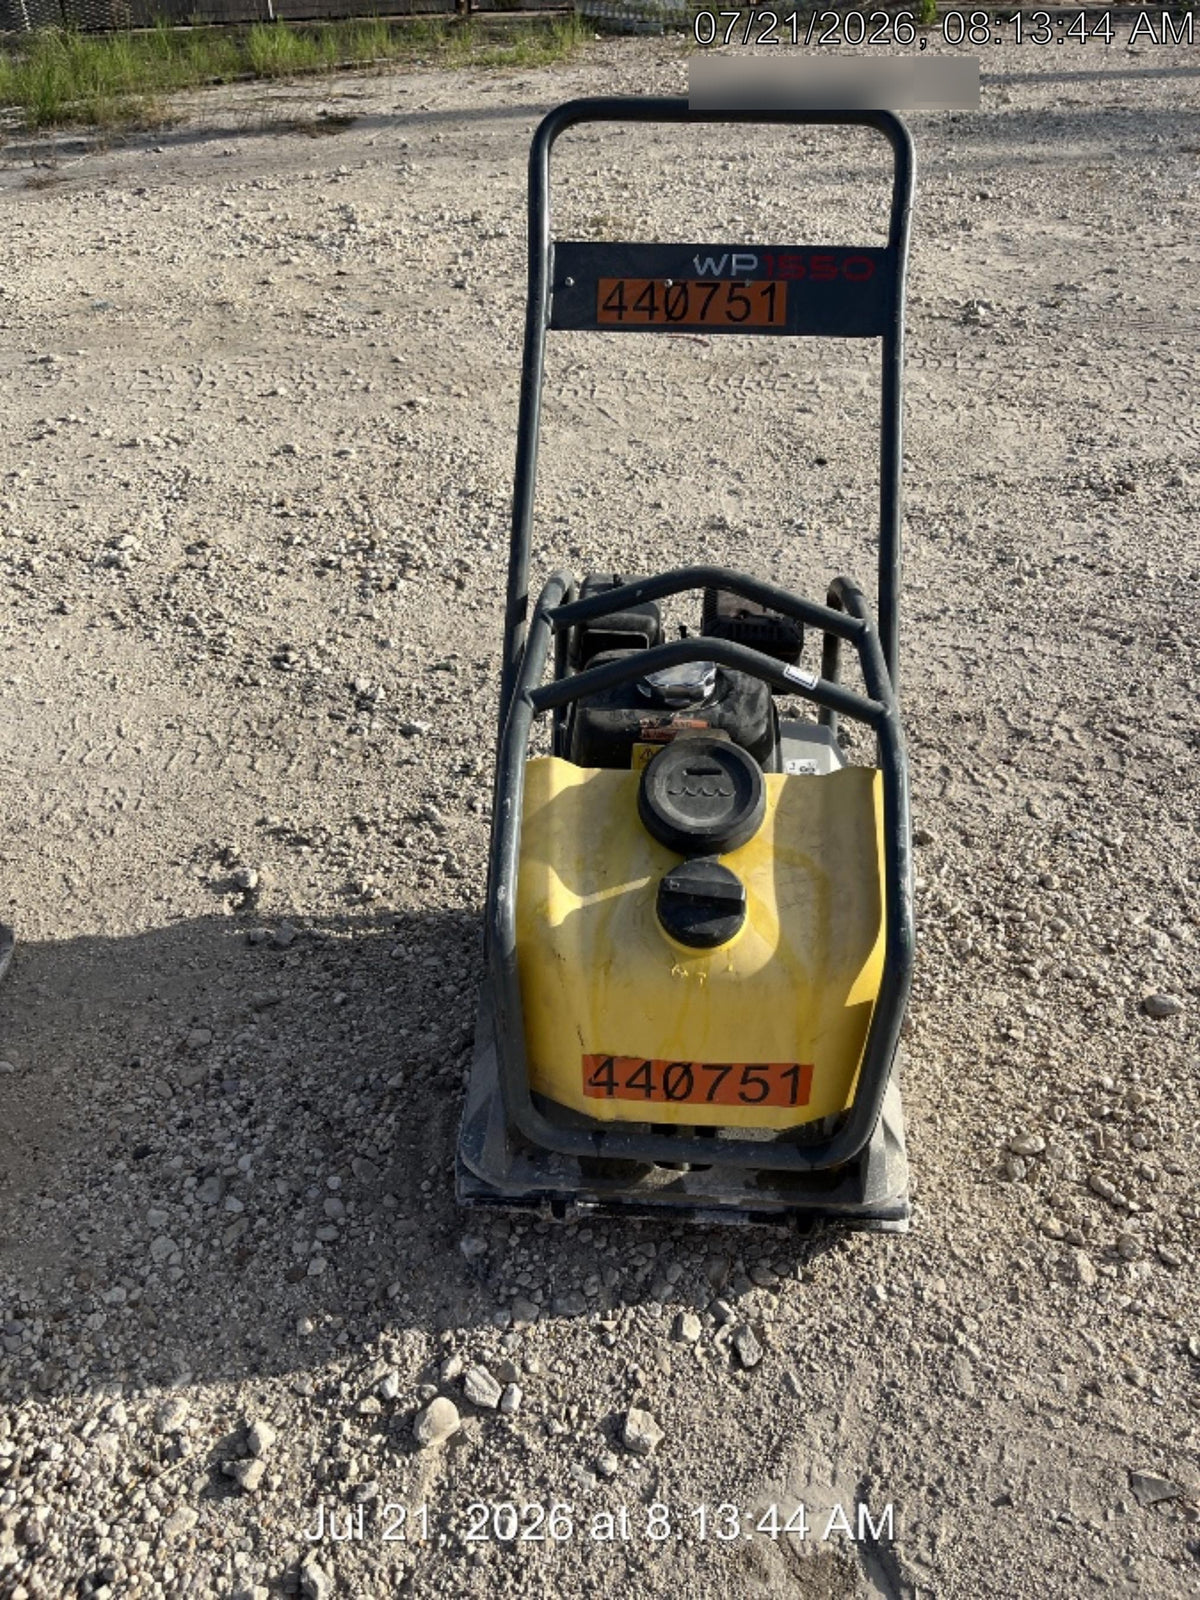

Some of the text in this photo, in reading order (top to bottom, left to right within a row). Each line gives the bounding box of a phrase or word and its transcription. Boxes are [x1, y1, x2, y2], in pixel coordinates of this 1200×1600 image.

[693, 253, 876, 282] WP1550
[602, 280, 777, 322] 440751
[588, 1056, 801, 1105] 440751
